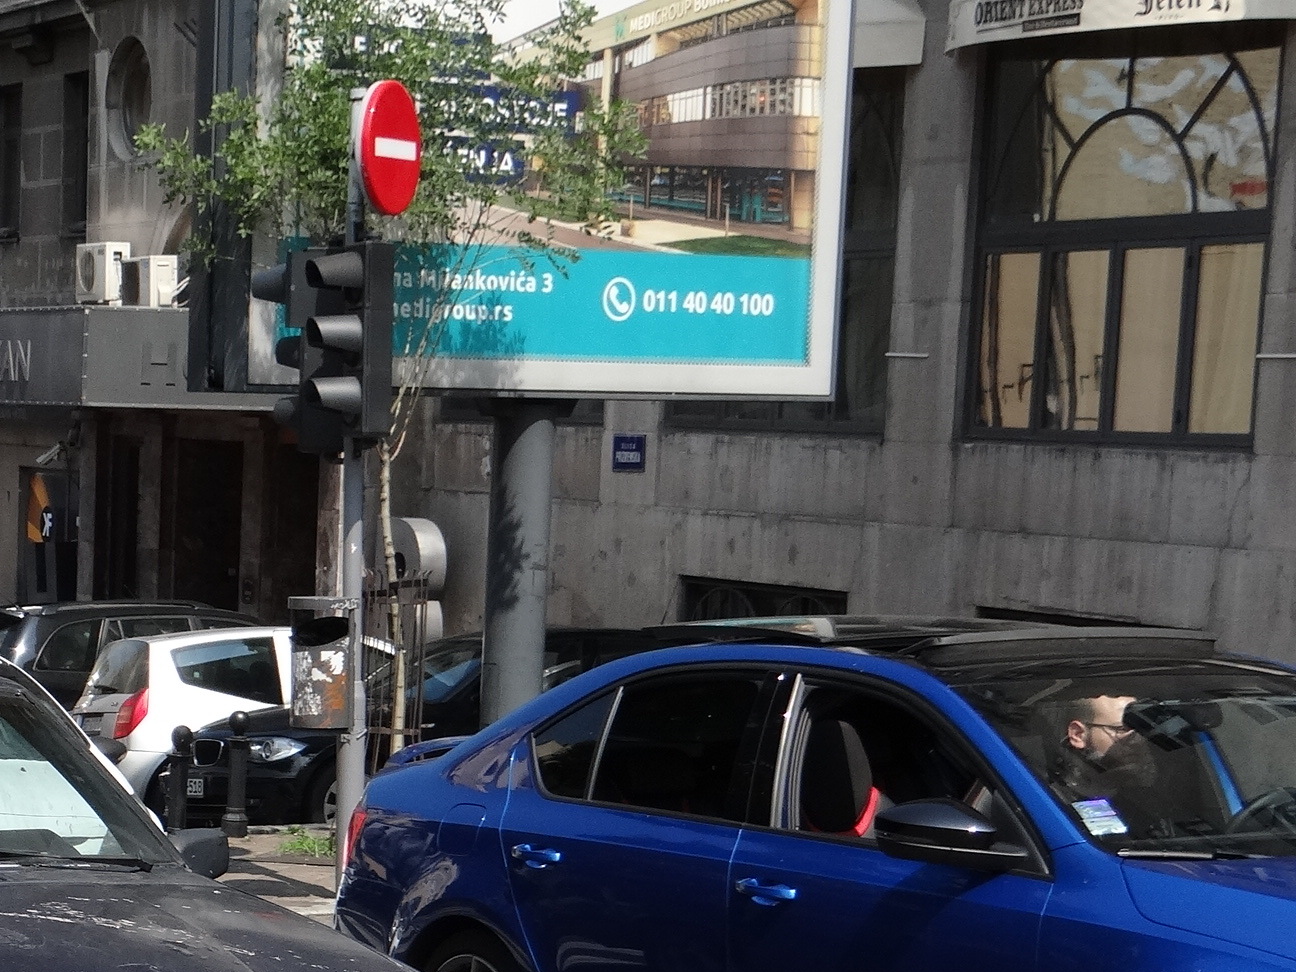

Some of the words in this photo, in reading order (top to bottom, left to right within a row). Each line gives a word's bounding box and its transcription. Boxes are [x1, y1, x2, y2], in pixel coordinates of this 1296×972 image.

[629, 2, 692, 33] MEDIGROUP
[541, 272, 553, 293] 3
[643, 289, 677, 313] 011
[682, 291, 707, 314] 40
[710, 292, 735, 315] 40
[739, 293, 774, 317] 100
